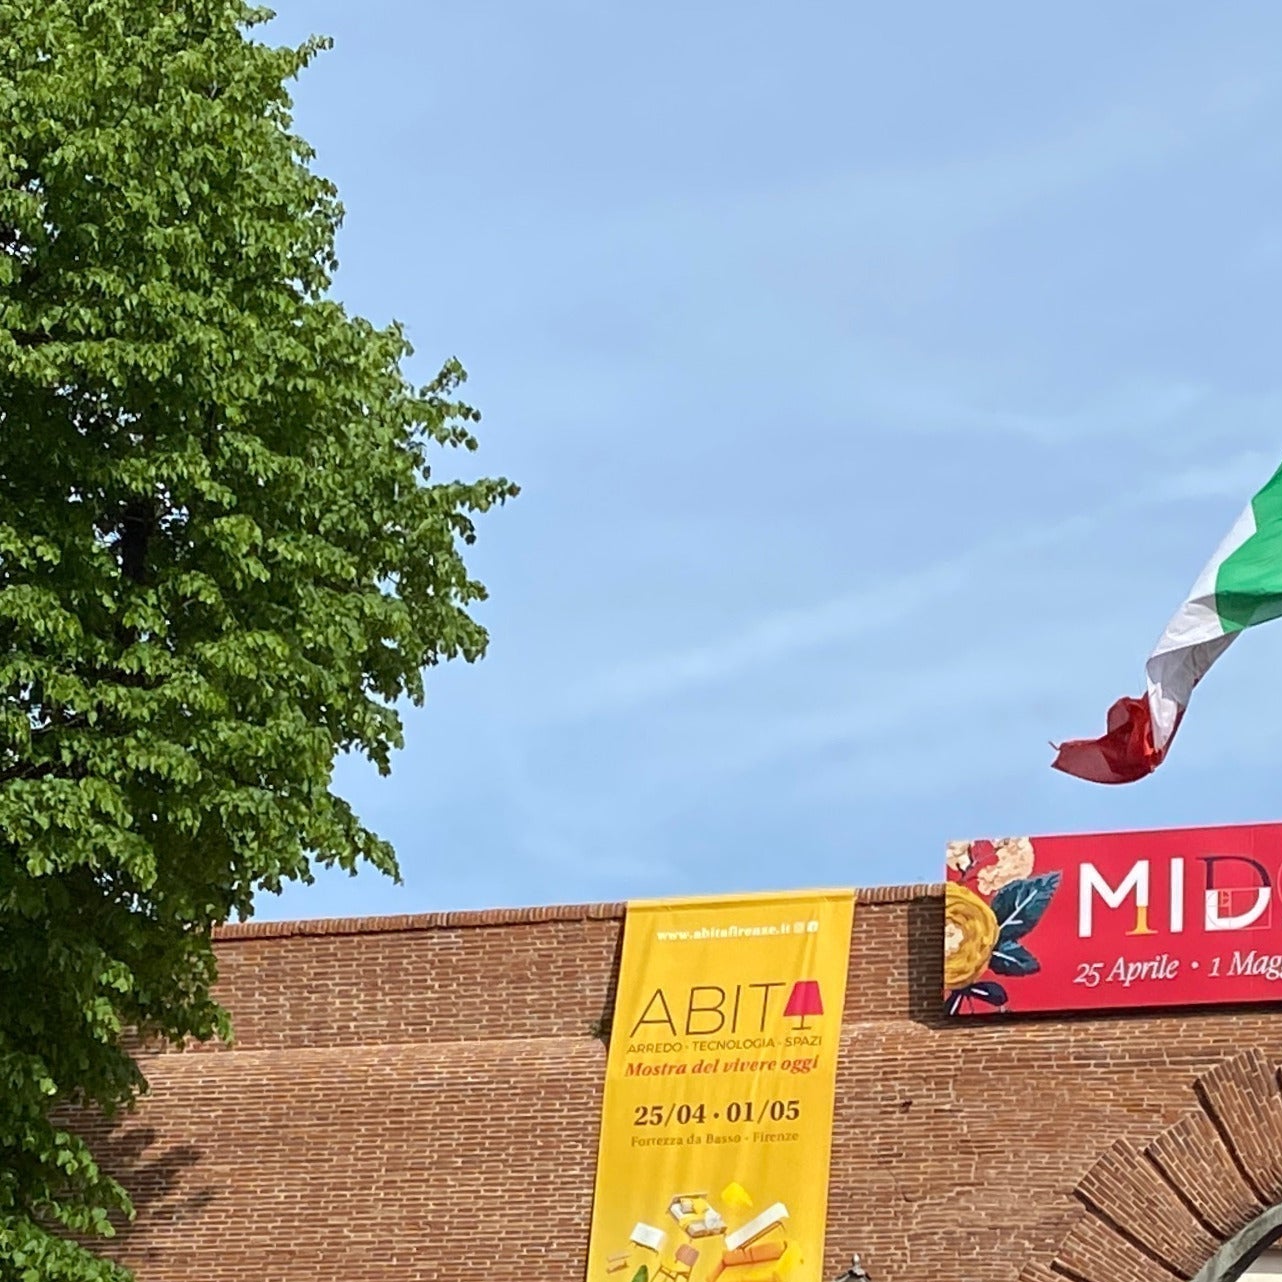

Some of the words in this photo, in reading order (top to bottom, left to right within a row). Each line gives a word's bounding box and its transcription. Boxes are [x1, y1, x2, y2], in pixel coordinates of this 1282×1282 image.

[1073, 962, 1104, 988] 25
[1106, 954, 1180, 986] Aprile
[1209, 958, 1219, 977] 1
[626, 1042, 683, 1054] ARREDO
[692, 1037, 776, 1051] TECNOLOGIA
[784, 1036, 822, 1048] SPAZI
[624, 1062, 688, 1077] Mostra
[691, 1058, 721, 1074] del
[723, 1057, 778, 1072] vivere
[780, 1054, 820, 1074] oggi
[633, 1103, 707, 1127] 25/04
[726, 1099, 801, 1124] 01/05
